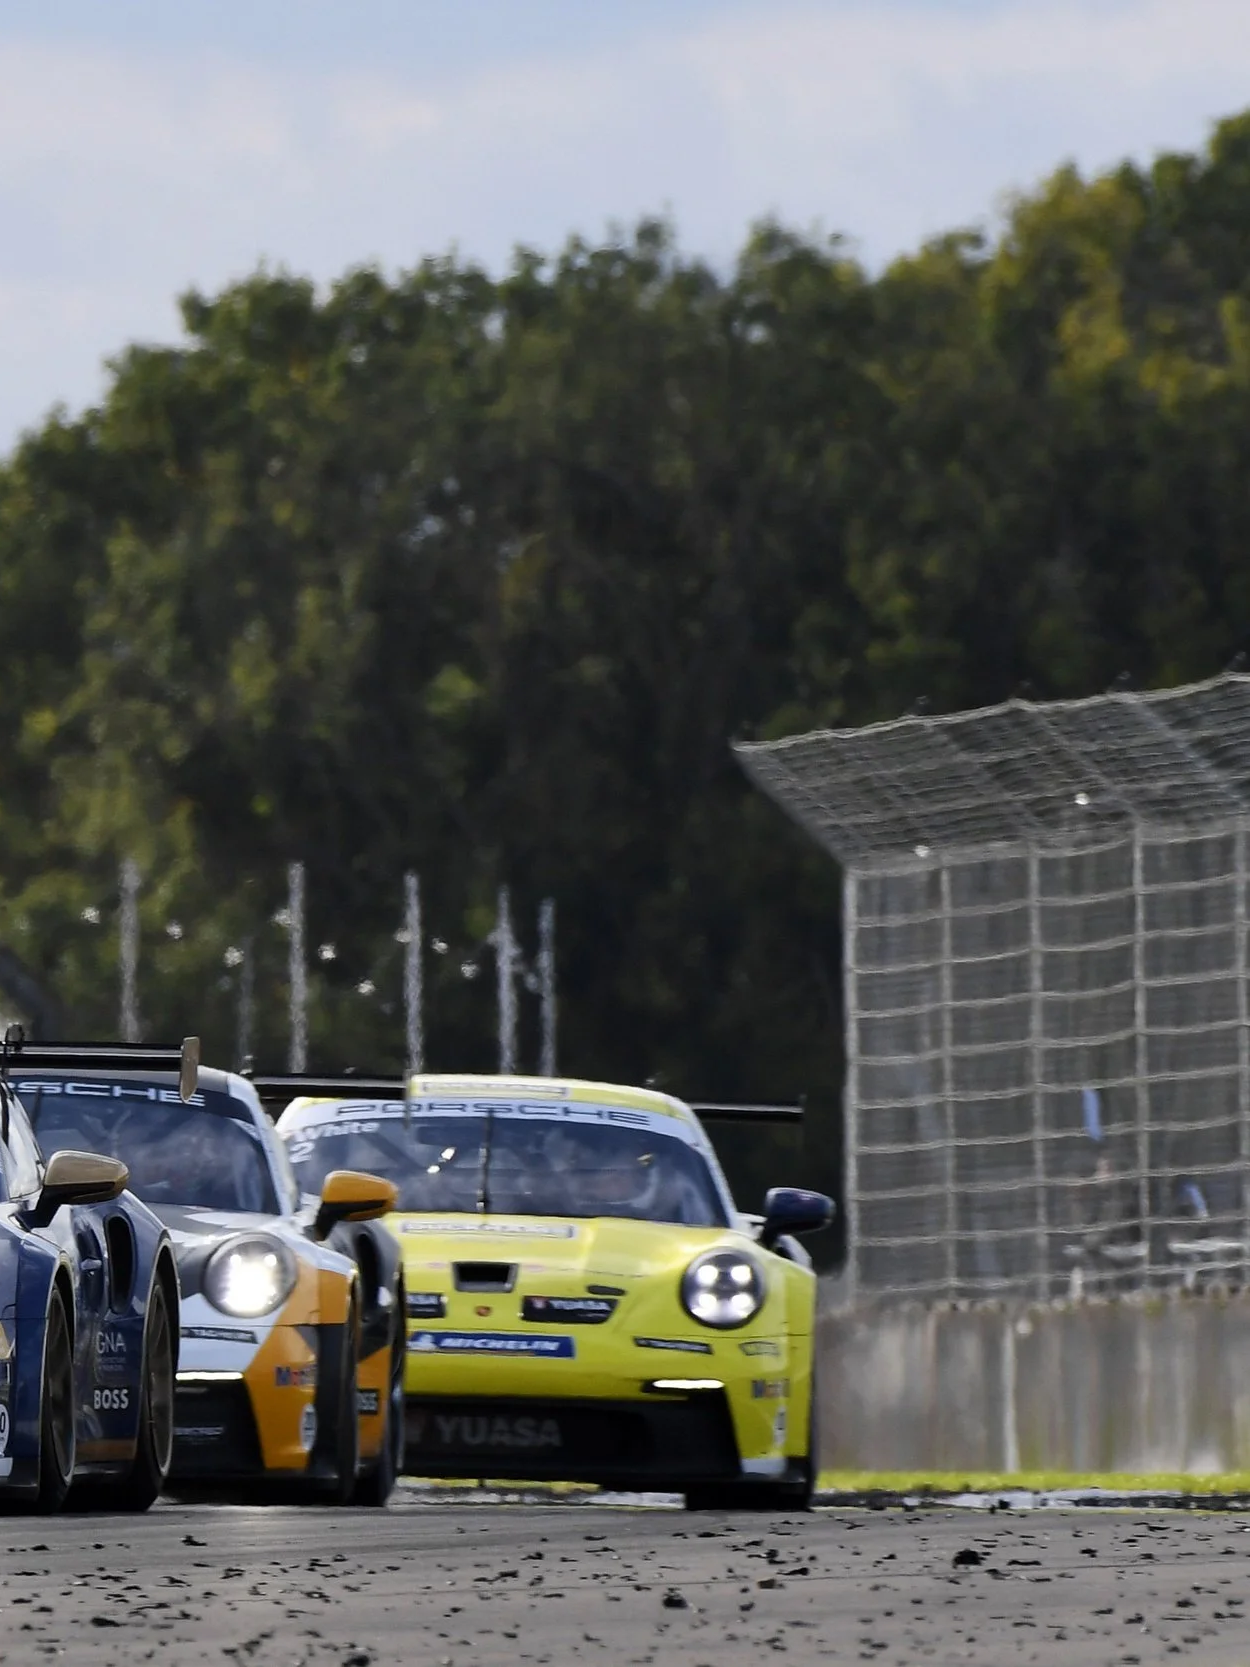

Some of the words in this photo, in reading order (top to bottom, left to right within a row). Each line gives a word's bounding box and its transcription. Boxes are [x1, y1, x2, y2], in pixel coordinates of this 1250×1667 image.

[7, 1081, 205, 1107] SCHE
[337, 1102, 651, 1126] PORSCHE
[293, 1119, 380, 1143] White
[289, 1142, 315, 1164] 2
[95, 1331, 127, 1354] GNA
[93, 1388, 129, 1410] BOSS
[434, 1414, 563, 1447] YUASA
